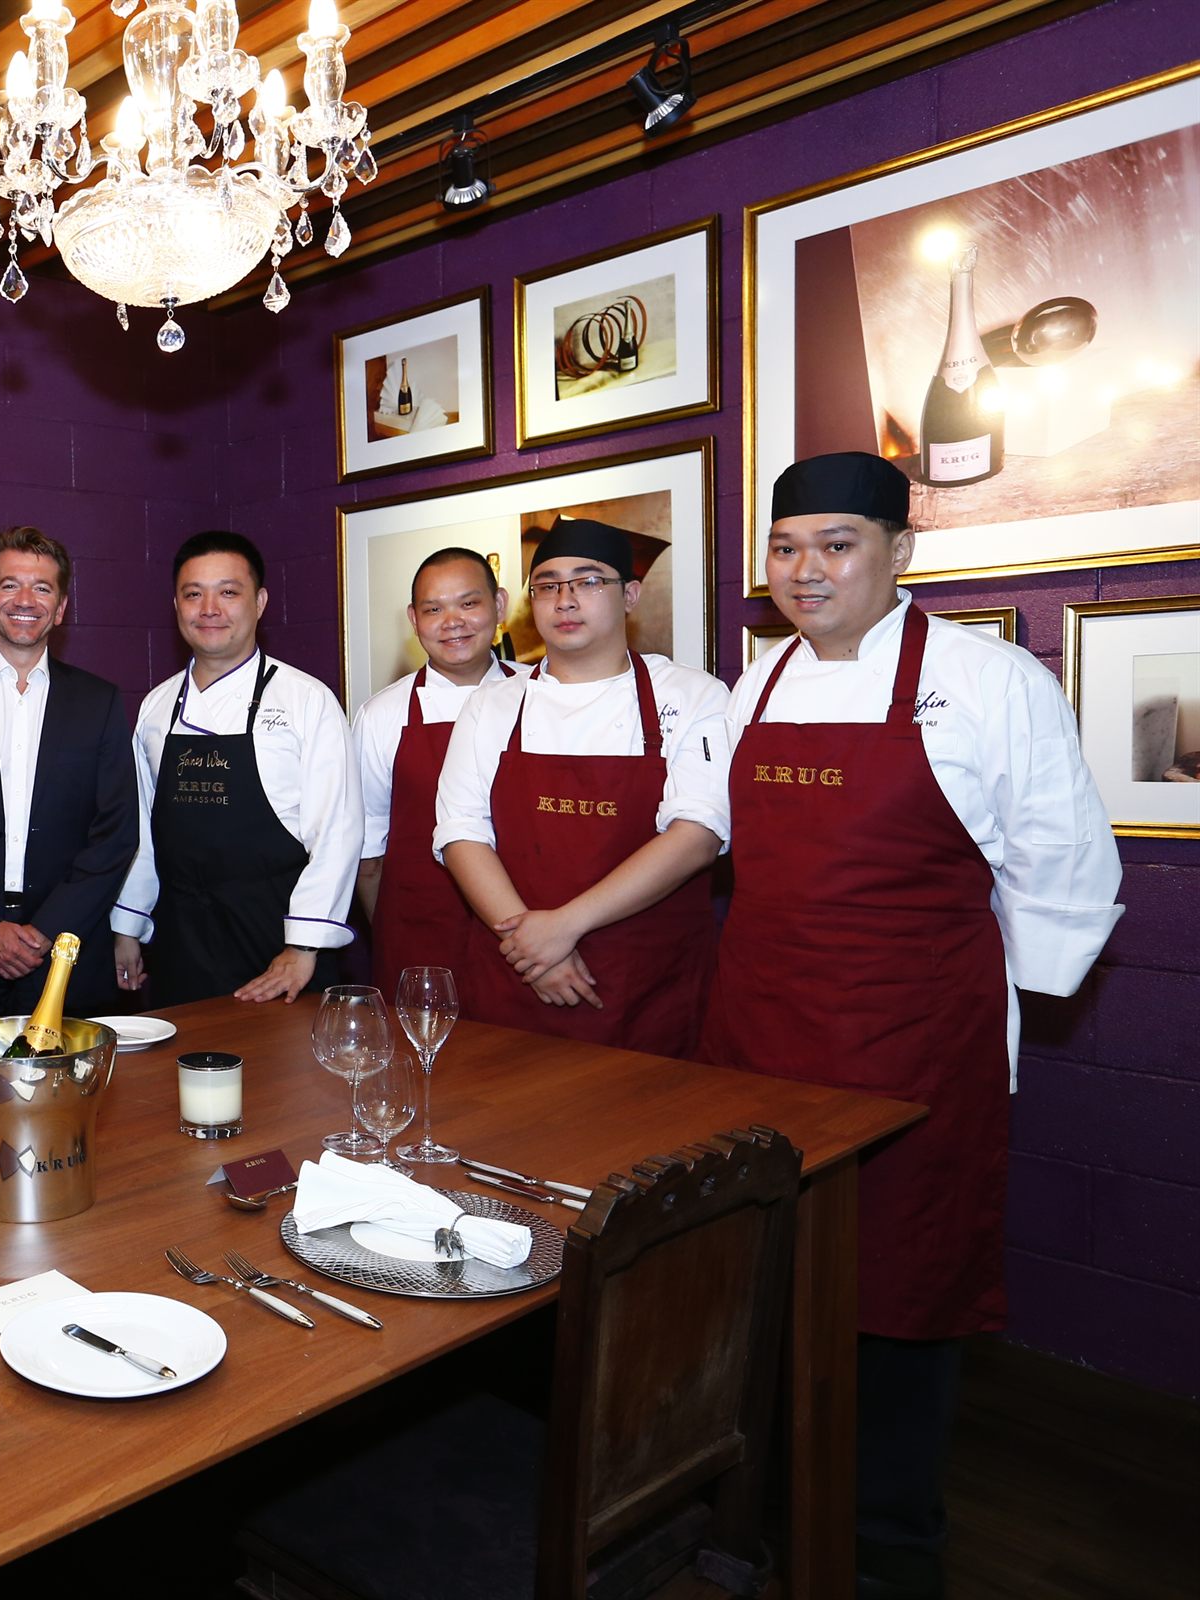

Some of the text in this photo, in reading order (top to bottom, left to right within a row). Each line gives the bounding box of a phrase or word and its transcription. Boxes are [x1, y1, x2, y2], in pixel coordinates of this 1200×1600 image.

[944, 356, 978, 369] KRUG
[940, 453, 980, 465] KRUG
[753, 763, 844, 786] KRUG
[178, 780, 225, 793] KRUG
[536, 795, 618, 817] KRUG
[244, 1158, 267, 1168] KRUG
